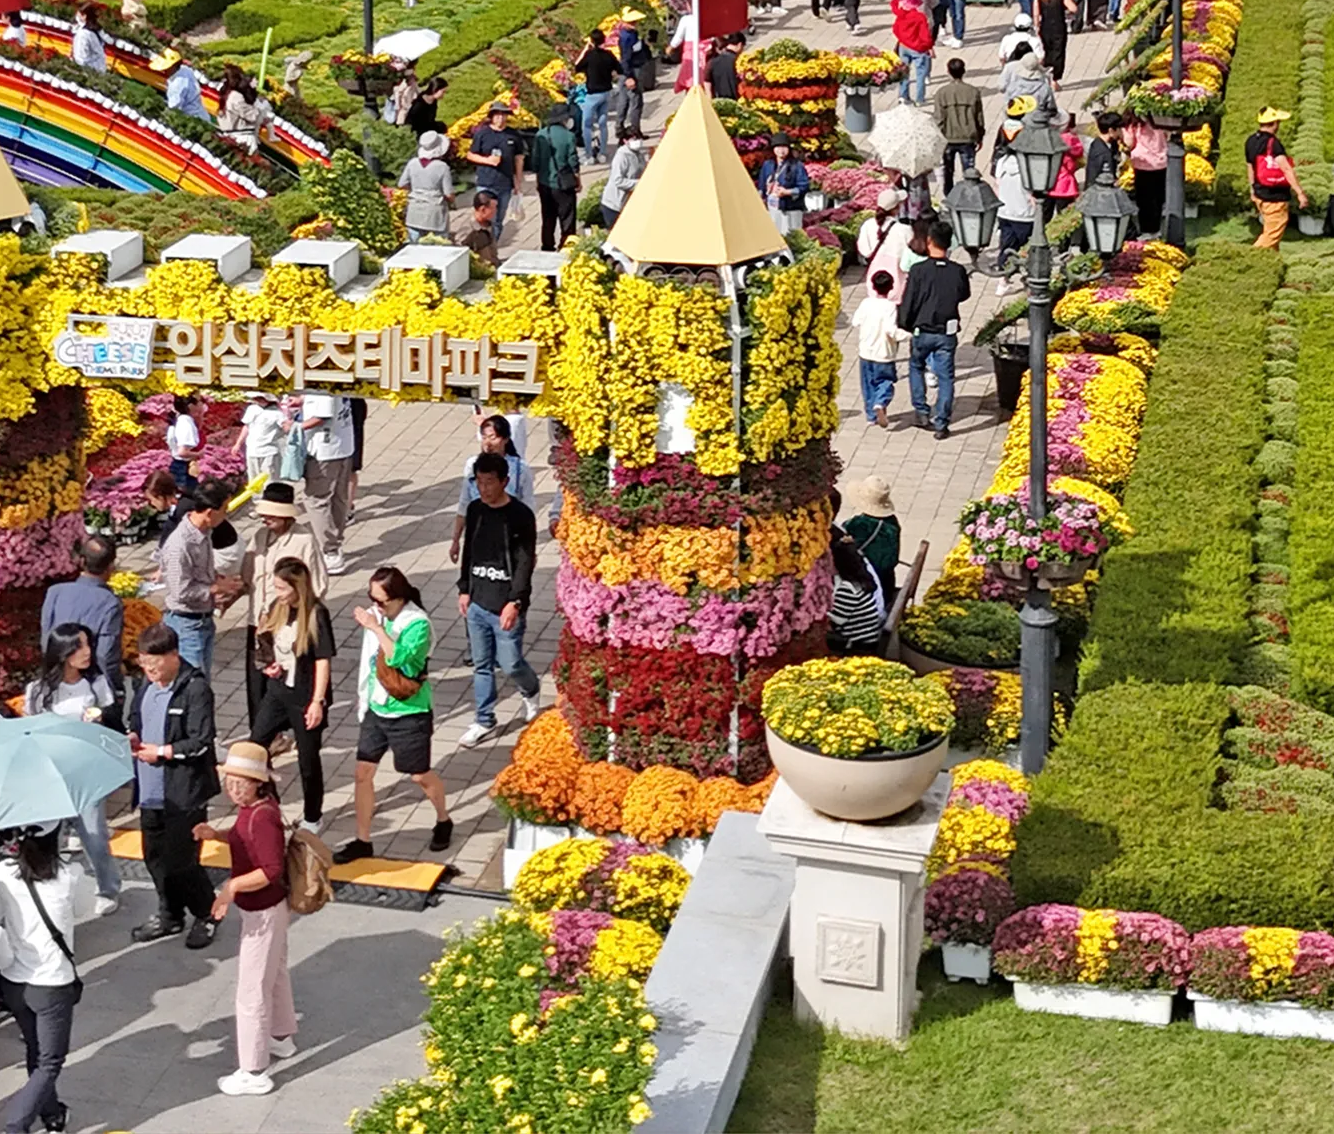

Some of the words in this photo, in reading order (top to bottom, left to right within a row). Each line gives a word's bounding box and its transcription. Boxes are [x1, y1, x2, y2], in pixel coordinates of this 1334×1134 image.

[57, 337, 147, 364] CHEESE
[168, 321, 544, 401] 임실치즈테마파크
[83, 364, 118, 374] THEME
[120, 365, 145, 376] PARK
